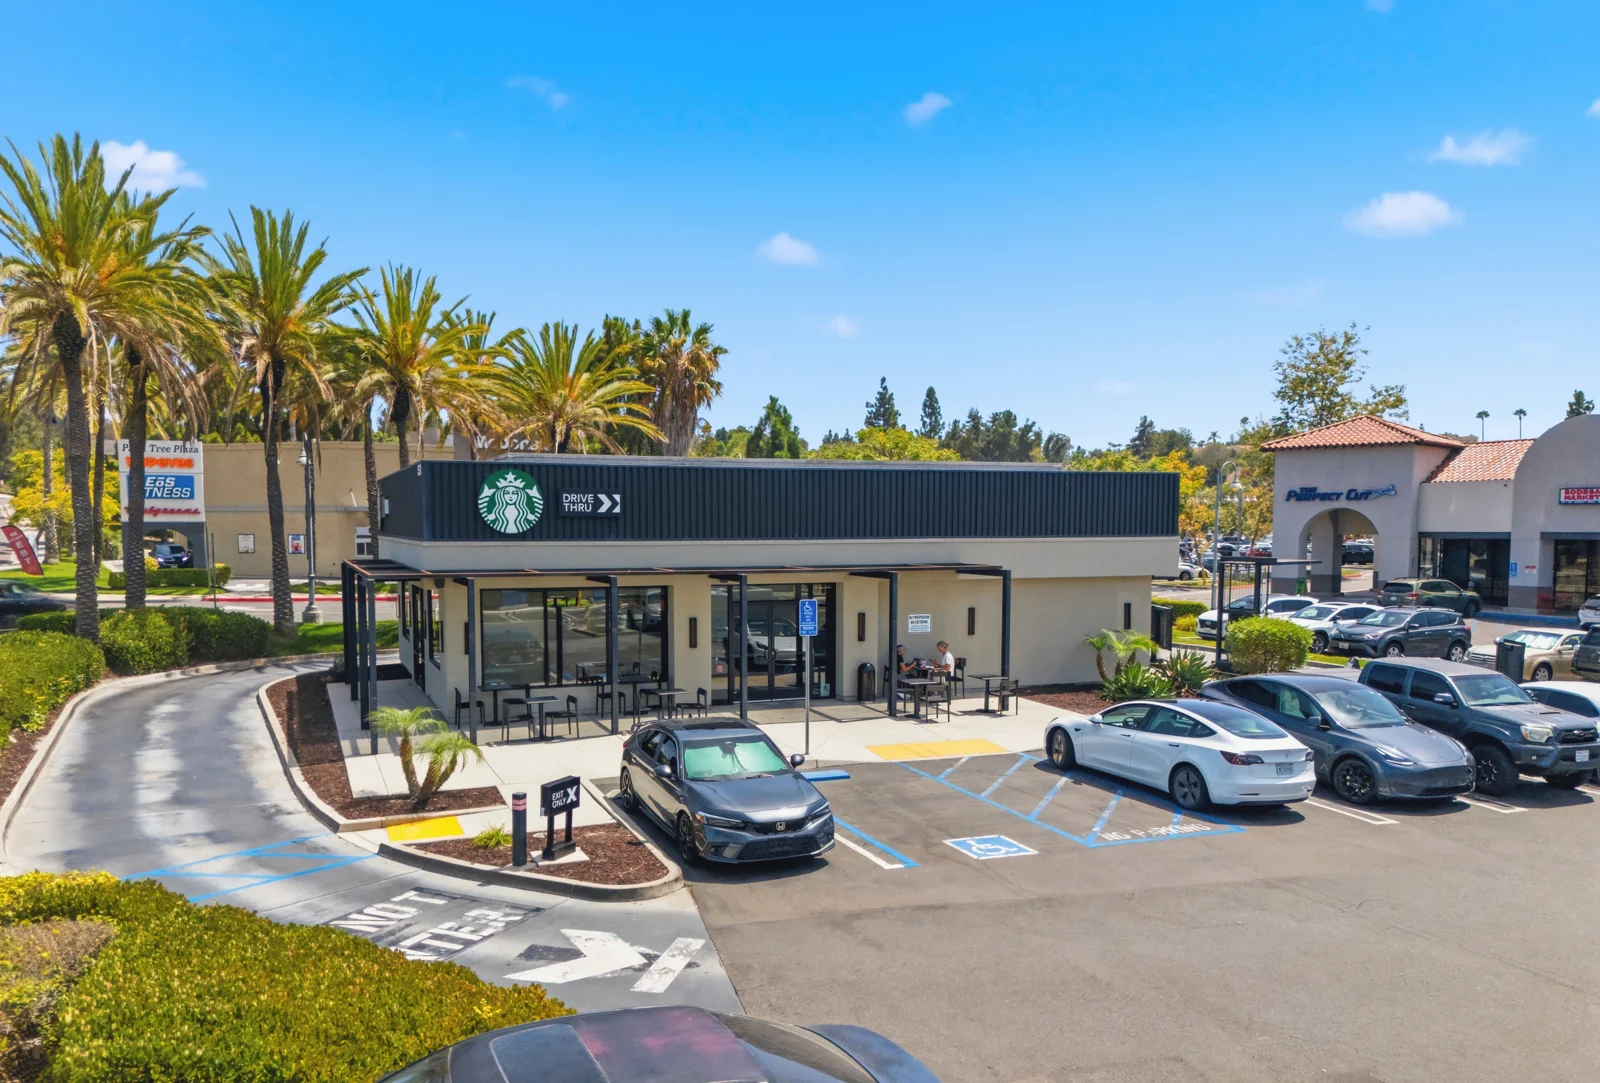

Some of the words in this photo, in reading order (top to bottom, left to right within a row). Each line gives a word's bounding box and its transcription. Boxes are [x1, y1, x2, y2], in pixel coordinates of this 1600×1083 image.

[150, 444, 171, 453] Tree
[144, 487, 191, 498] TNESS
[562, 493, 594, 503] DRIVE
[1345, 488, 1373, 501] CUT
[563, 503, 592, 513] THRU
[552, 789, 564, 801] EXIT
[552, 797, 567, 808] ONLY
[1098, 831, 1132, 841] NO
[328, 890, 448, 933] NOT
